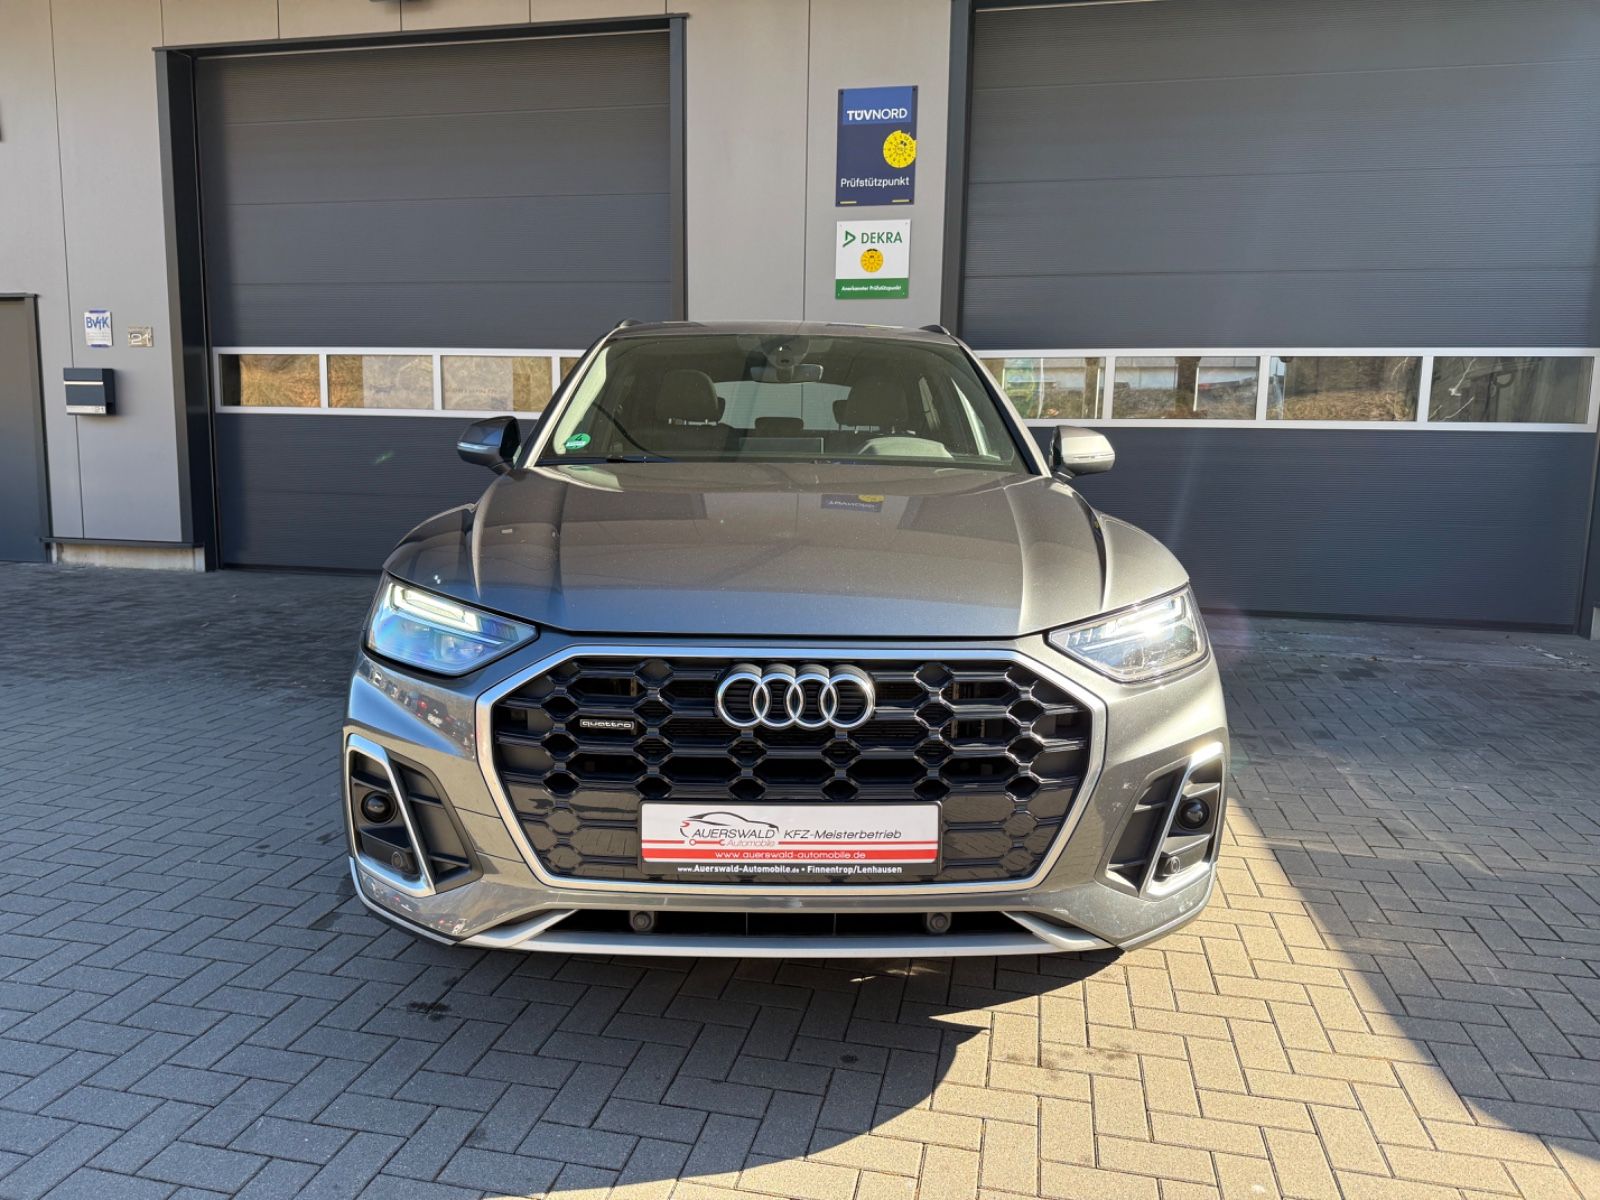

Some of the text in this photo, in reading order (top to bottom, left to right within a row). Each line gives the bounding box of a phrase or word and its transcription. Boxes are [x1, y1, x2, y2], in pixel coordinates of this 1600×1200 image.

[840, 176, 910, 189] Prüfstützpunkt
[861, 231, 903, 244] DEKRA
[869, 284, 902, 292] Prüfstützpunkt
[692, 829, 902, 840] AUERSWALD KFZ-Meisterbetrieb
[726, 839, 775, 847] Automobile
[715, 849, 866, 860] www.auerswald-automobile.de
[678, 864, 903, 874] www.Auerswald-Automobile.de Finnentrop/Lenhausen
